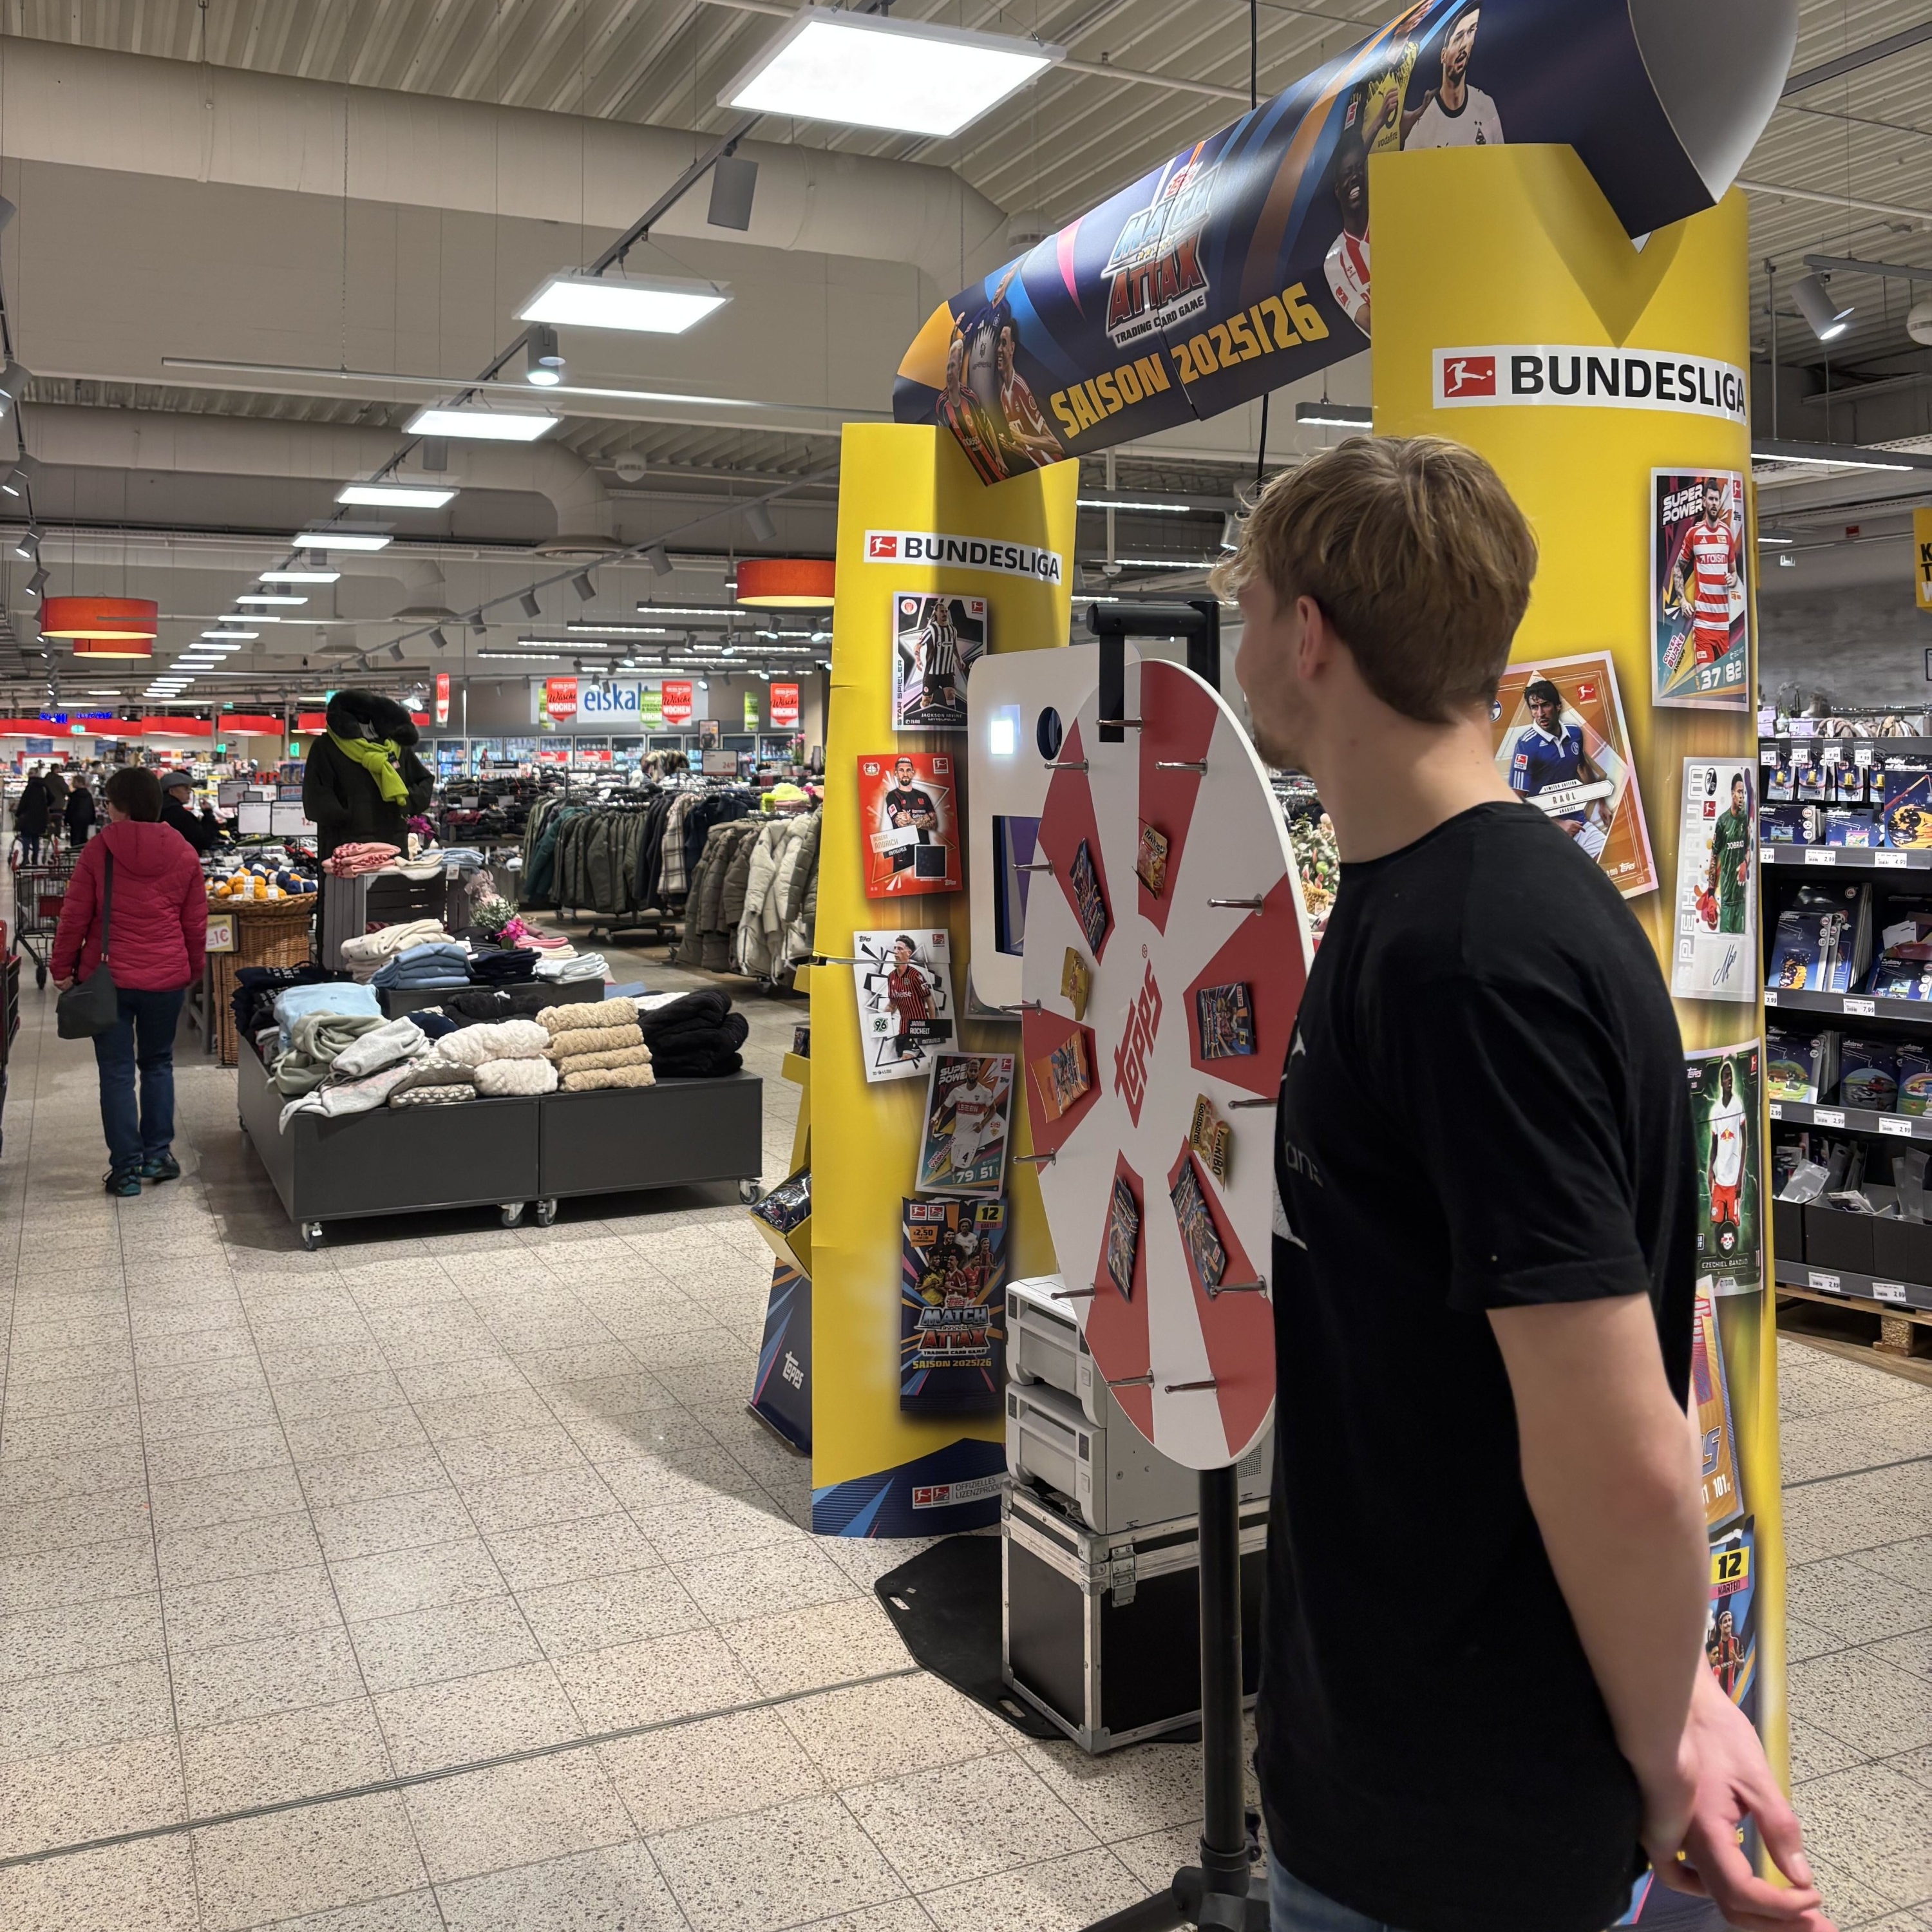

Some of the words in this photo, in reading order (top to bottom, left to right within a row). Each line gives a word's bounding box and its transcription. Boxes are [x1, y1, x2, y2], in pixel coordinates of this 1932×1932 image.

[1113, 171, 1215, 261] MATCH
[1108, 237, 1206, 326] ATTAX
[1115, 321, 1152, 343] TRADING
[1154, 310, 1177, 328] CARD
[1179, 296, 1204, 317] GAME
[1050, 353, 1170, 439] SAISON
[1171, 282, 1329, 384] 2025/26
[1511, 355, 1746, 416] BUNDESLIGA
[1663, 484, 1703, 511] SUPER
[1662, 498, 1703, 526] POWER
[905, 537, 1059, 580] BUNDESLIGA
[1707, 554, 1727, 563] raisin
[1663, 636, 1678, 663] OLIVER
[1667, 634, 1685, 668] BURKE
[1701, 667, 1721, 690] 37
[1726, 660, 1742, 683] 82
[584, 682, 648, 711] eiskal
[548, 703, 576, 712] WOCHEN
[663, 705, 691, 715] WOCHEN
[875, 838, 899, 849] ANDRICH
[875, 1018, 887, 1030] 96
[938, 1071, 967, 1085] POWE
[940, 1063, 967, 1077] SUPE
[962, 1152, 969, 1163] 4
[956, 1170, 974, 1184] 79
[980, 1166, 993, 1180] 51
[982, 1207, 999, 1220] 12
[921, 1307, 987, 1326] MATCH
[920, 1328, 990, 1349] ATTAX
[913, 1359, 951, 1369] SAISON
[952, 1358, 992, 1367] 2025/26
[955, 1477, 996, 1492] OFFIZIELLES
[956, 1482, 1003, 1499] LIZENZPRODU
[1718, 1551, 1742, 1580] 12
